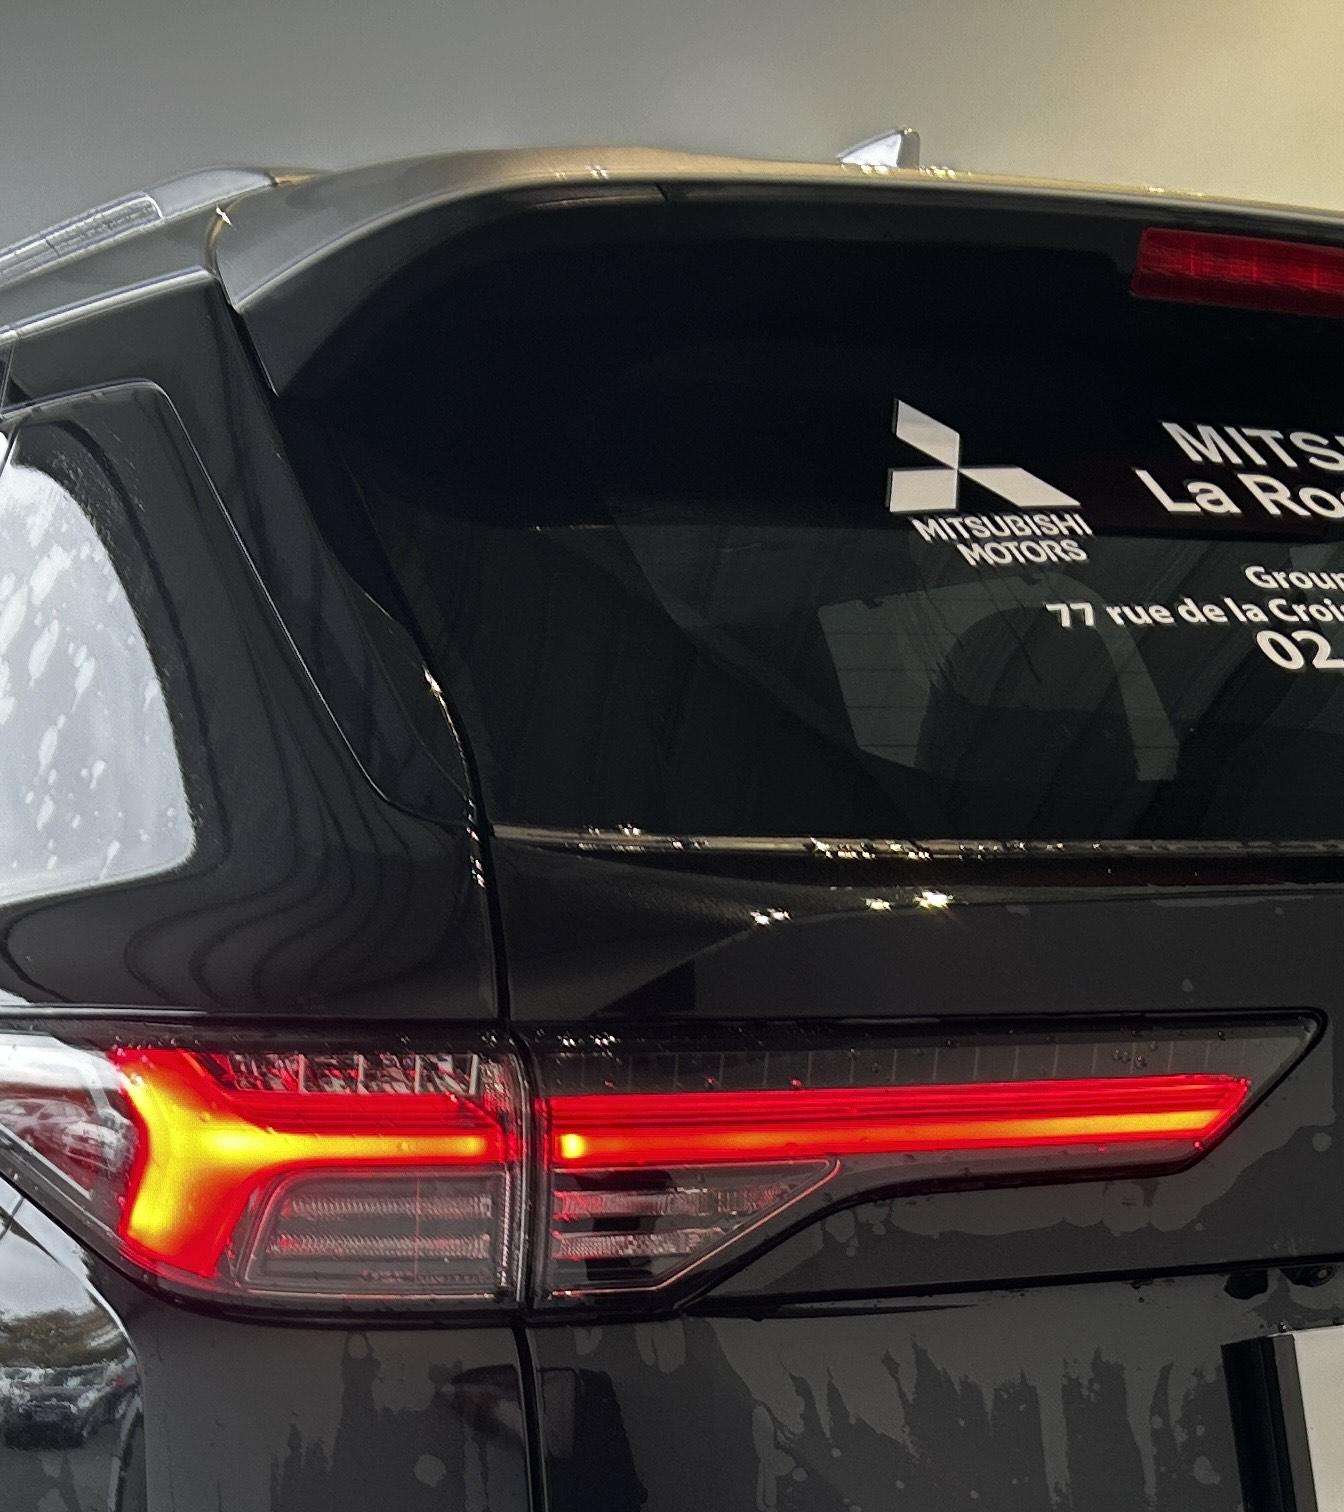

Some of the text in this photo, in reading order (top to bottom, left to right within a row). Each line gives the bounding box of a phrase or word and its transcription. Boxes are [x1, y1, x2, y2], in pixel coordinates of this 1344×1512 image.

[1134, 469, 1242, 514] La
[911, 512, 1093, 543] MITSUBISHI
[956, 539, 1089, 567] MOTORS
[1045, 602, 1095, 628] 77
[1105, 602, 1175, 626] rue
[1177, 597, 1228, 624] de
[1223, 597, 1269, 624] la
